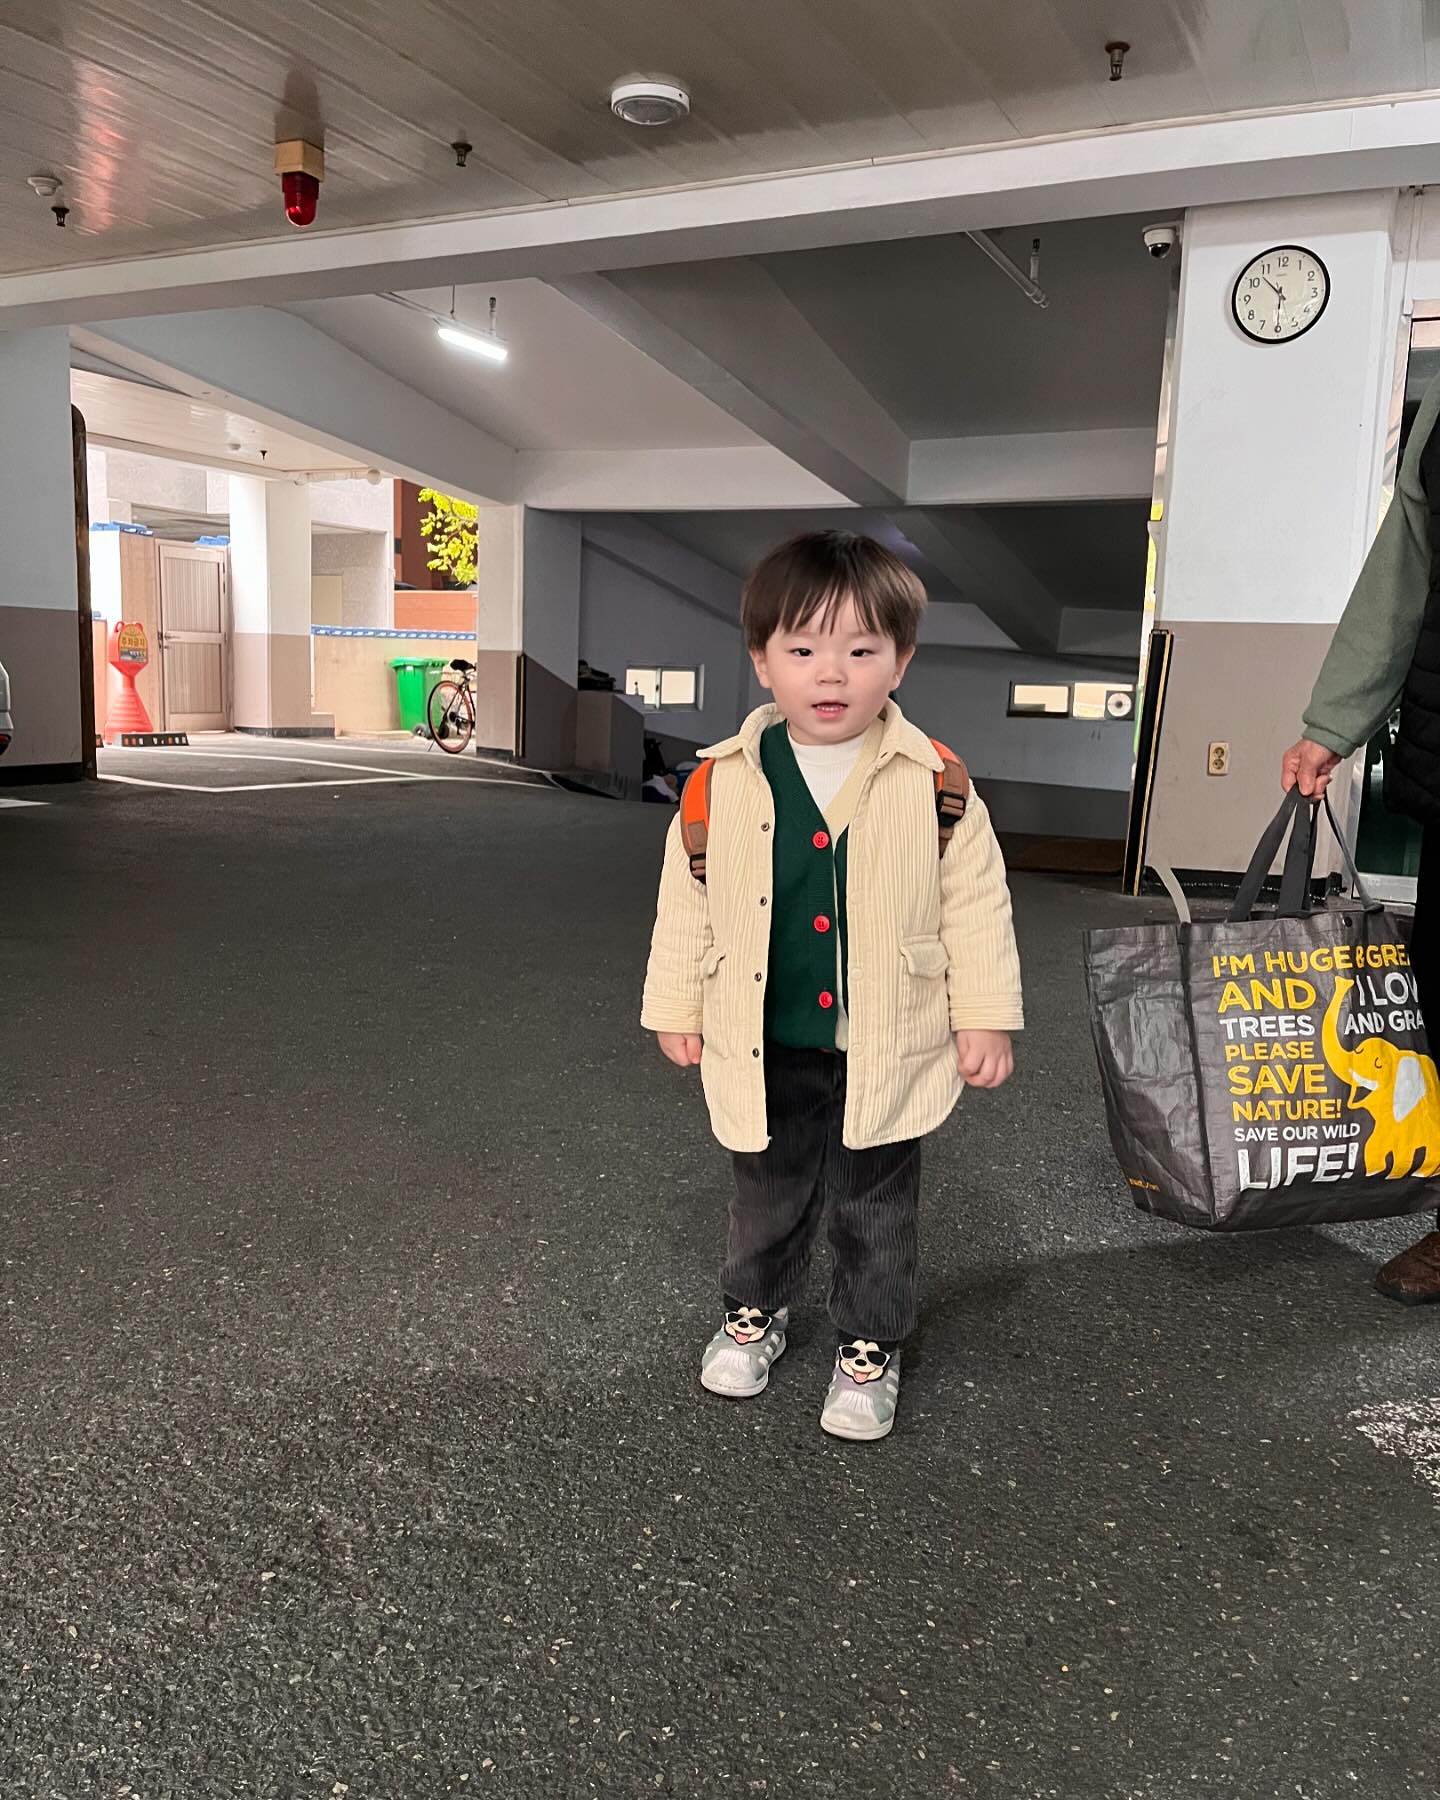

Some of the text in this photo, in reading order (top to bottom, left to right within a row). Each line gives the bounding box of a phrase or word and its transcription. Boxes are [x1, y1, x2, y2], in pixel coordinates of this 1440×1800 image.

[1277, 256, 1289, 267] 12
[1262, 264, 1270, 275] 11
[1308, 270, 1315, 281] 2
[1249, 277, 1261, 288] 10
[1244, 294, 1251, 304] 9
[1311, 287, 1318, 299] 3
[1248, 309, 1254, 320] 8
[1260, 320, 1266, 330] 7
[1213, 953, 1255, 977] I'M
[1265, 946, 1353, 973] HUGE
[1366, 943, 1411, 968] GRE
[1217, 978, 1317, 1014] AND
[1356, 974, 1366, 1006] I
[1219, 1015, 1315, 1040] TREES
[1344, 1011, 1385, 1035] AND
[1225, 1041, 1315, 1062] PLEASE
[1228, 1064, 1328, 1096] SAVE
[1232, 1099, 1342, 1122] NATURE!
[1234, 1123, 1361, 1142] SAVE OUR WILD
[1238, 1143, 1359, 1192] LIFE!
